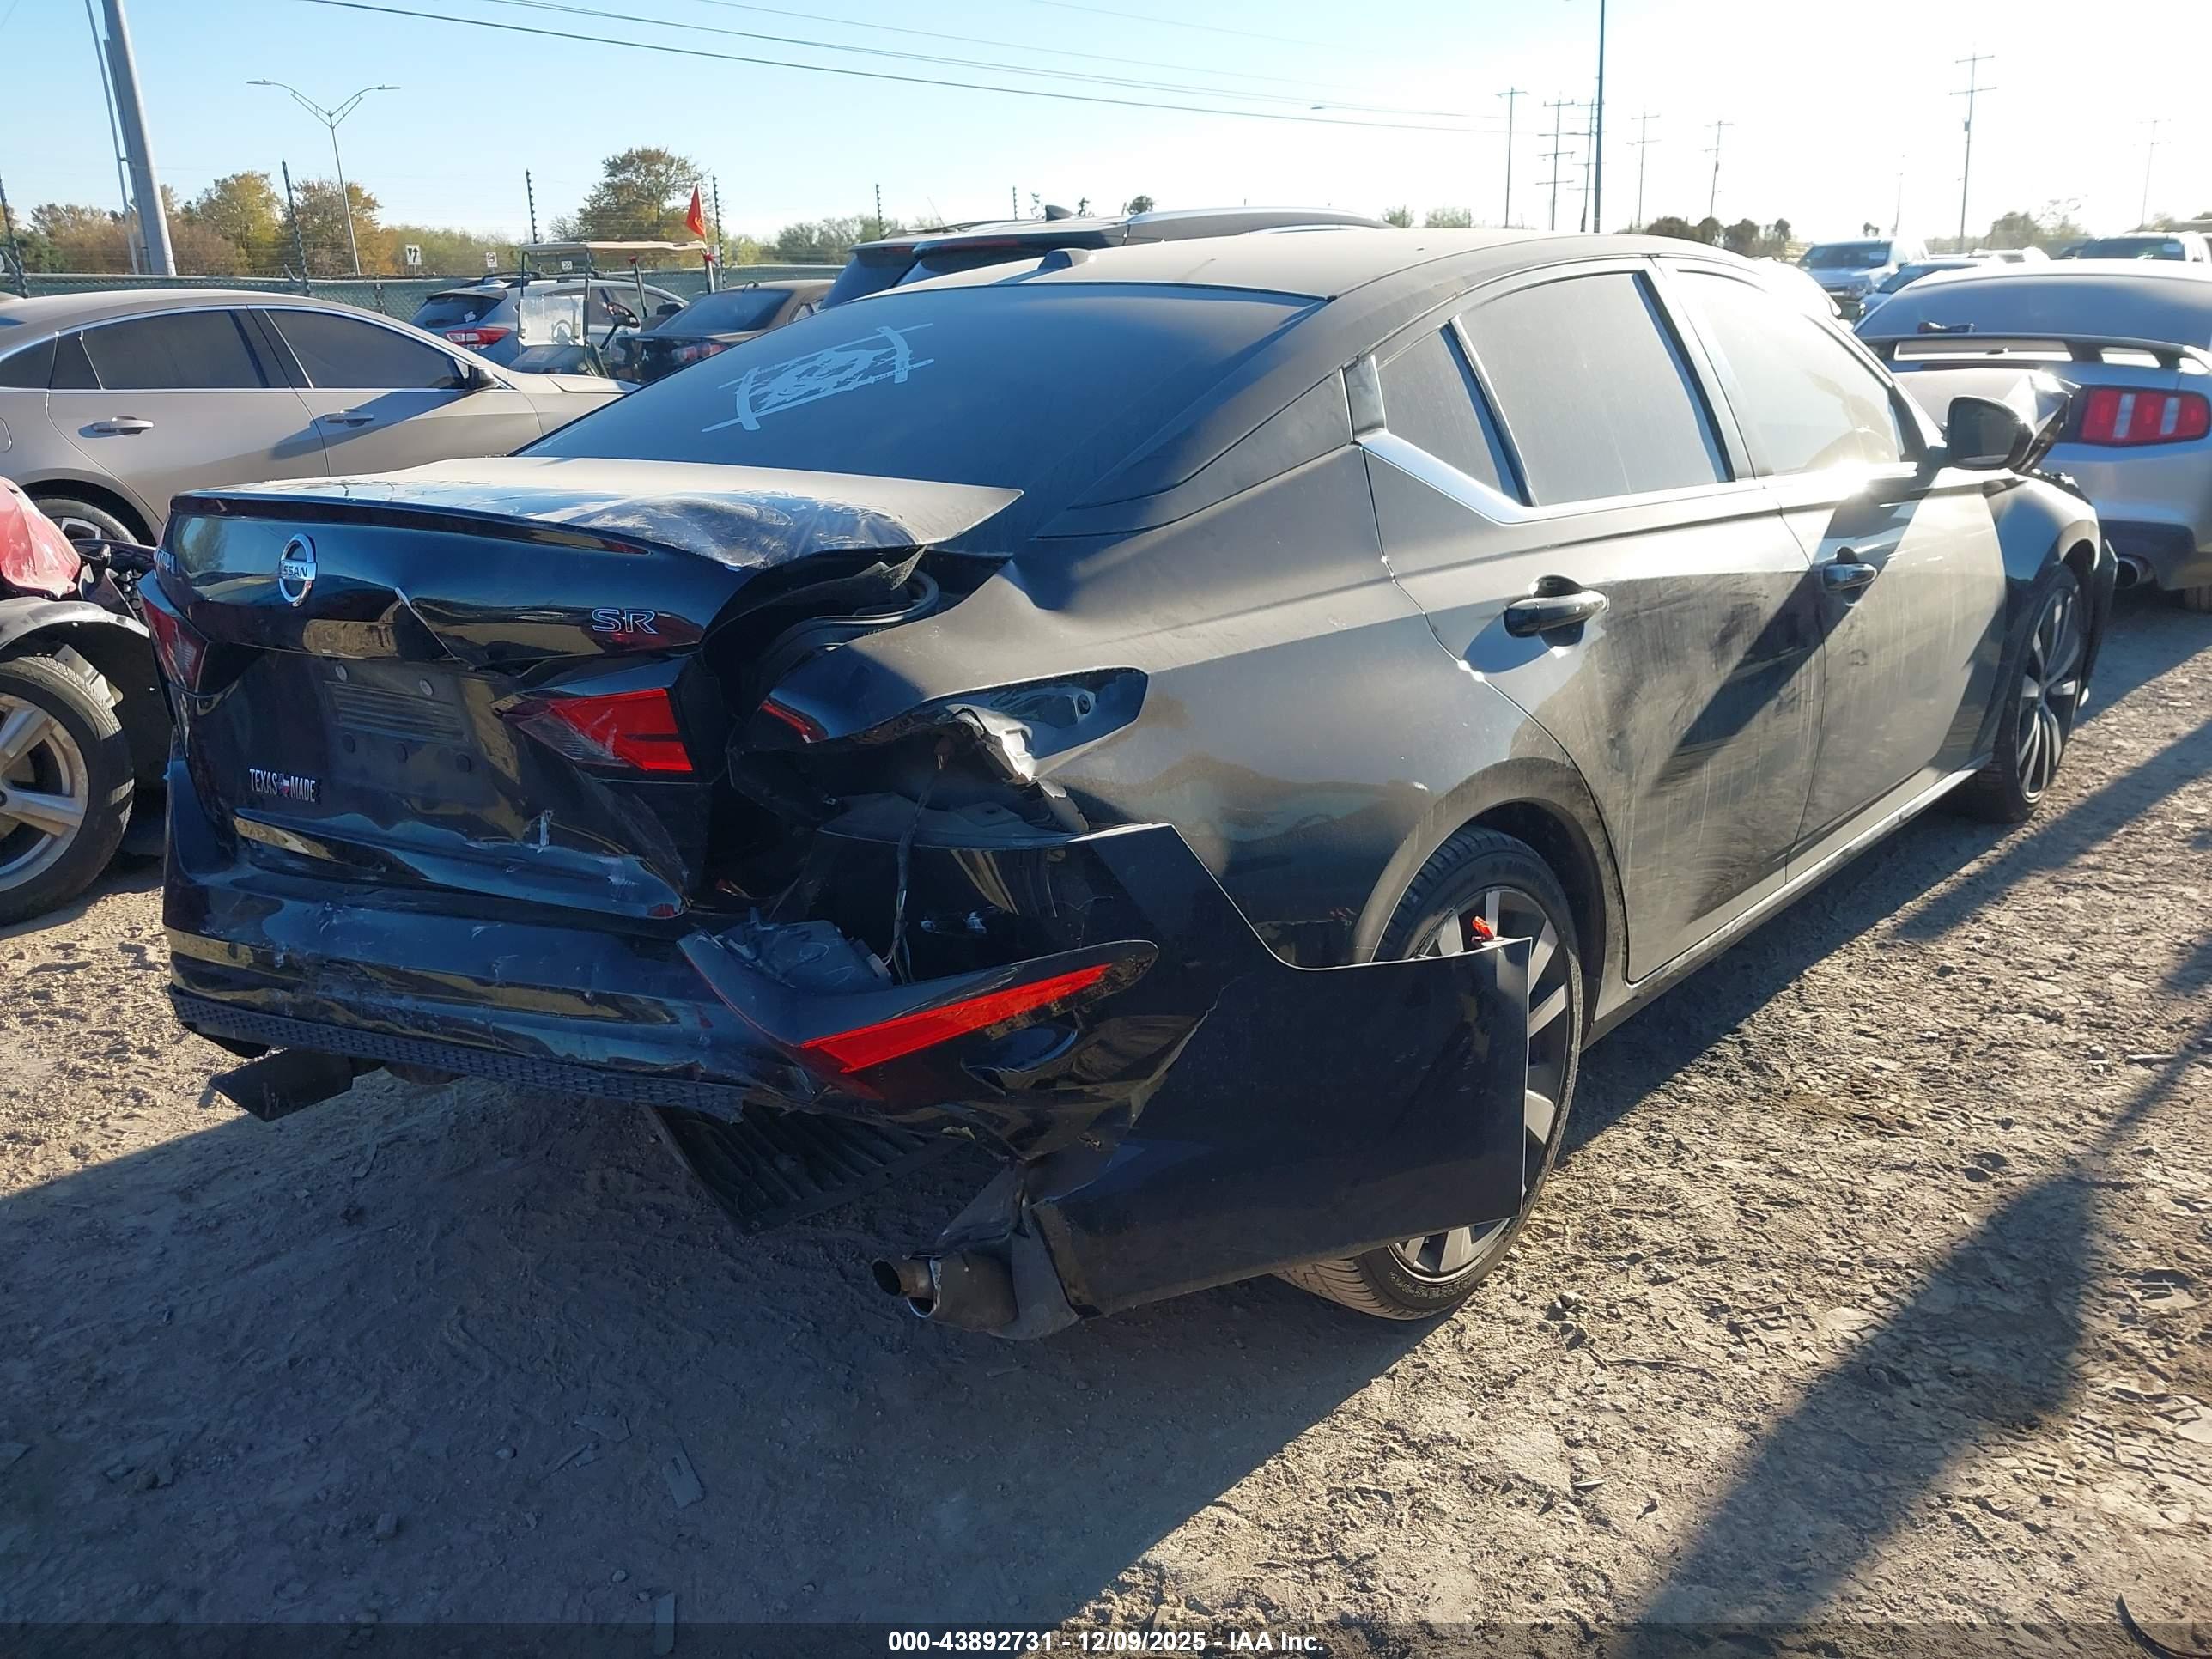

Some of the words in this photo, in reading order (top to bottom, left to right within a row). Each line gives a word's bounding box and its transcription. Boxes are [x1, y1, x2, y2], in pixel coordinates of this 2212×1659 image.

[592, 608, 659, 635] SR
[249, 768, 278, 796] TEXAS
[290, 775, 316, 803] MADE
